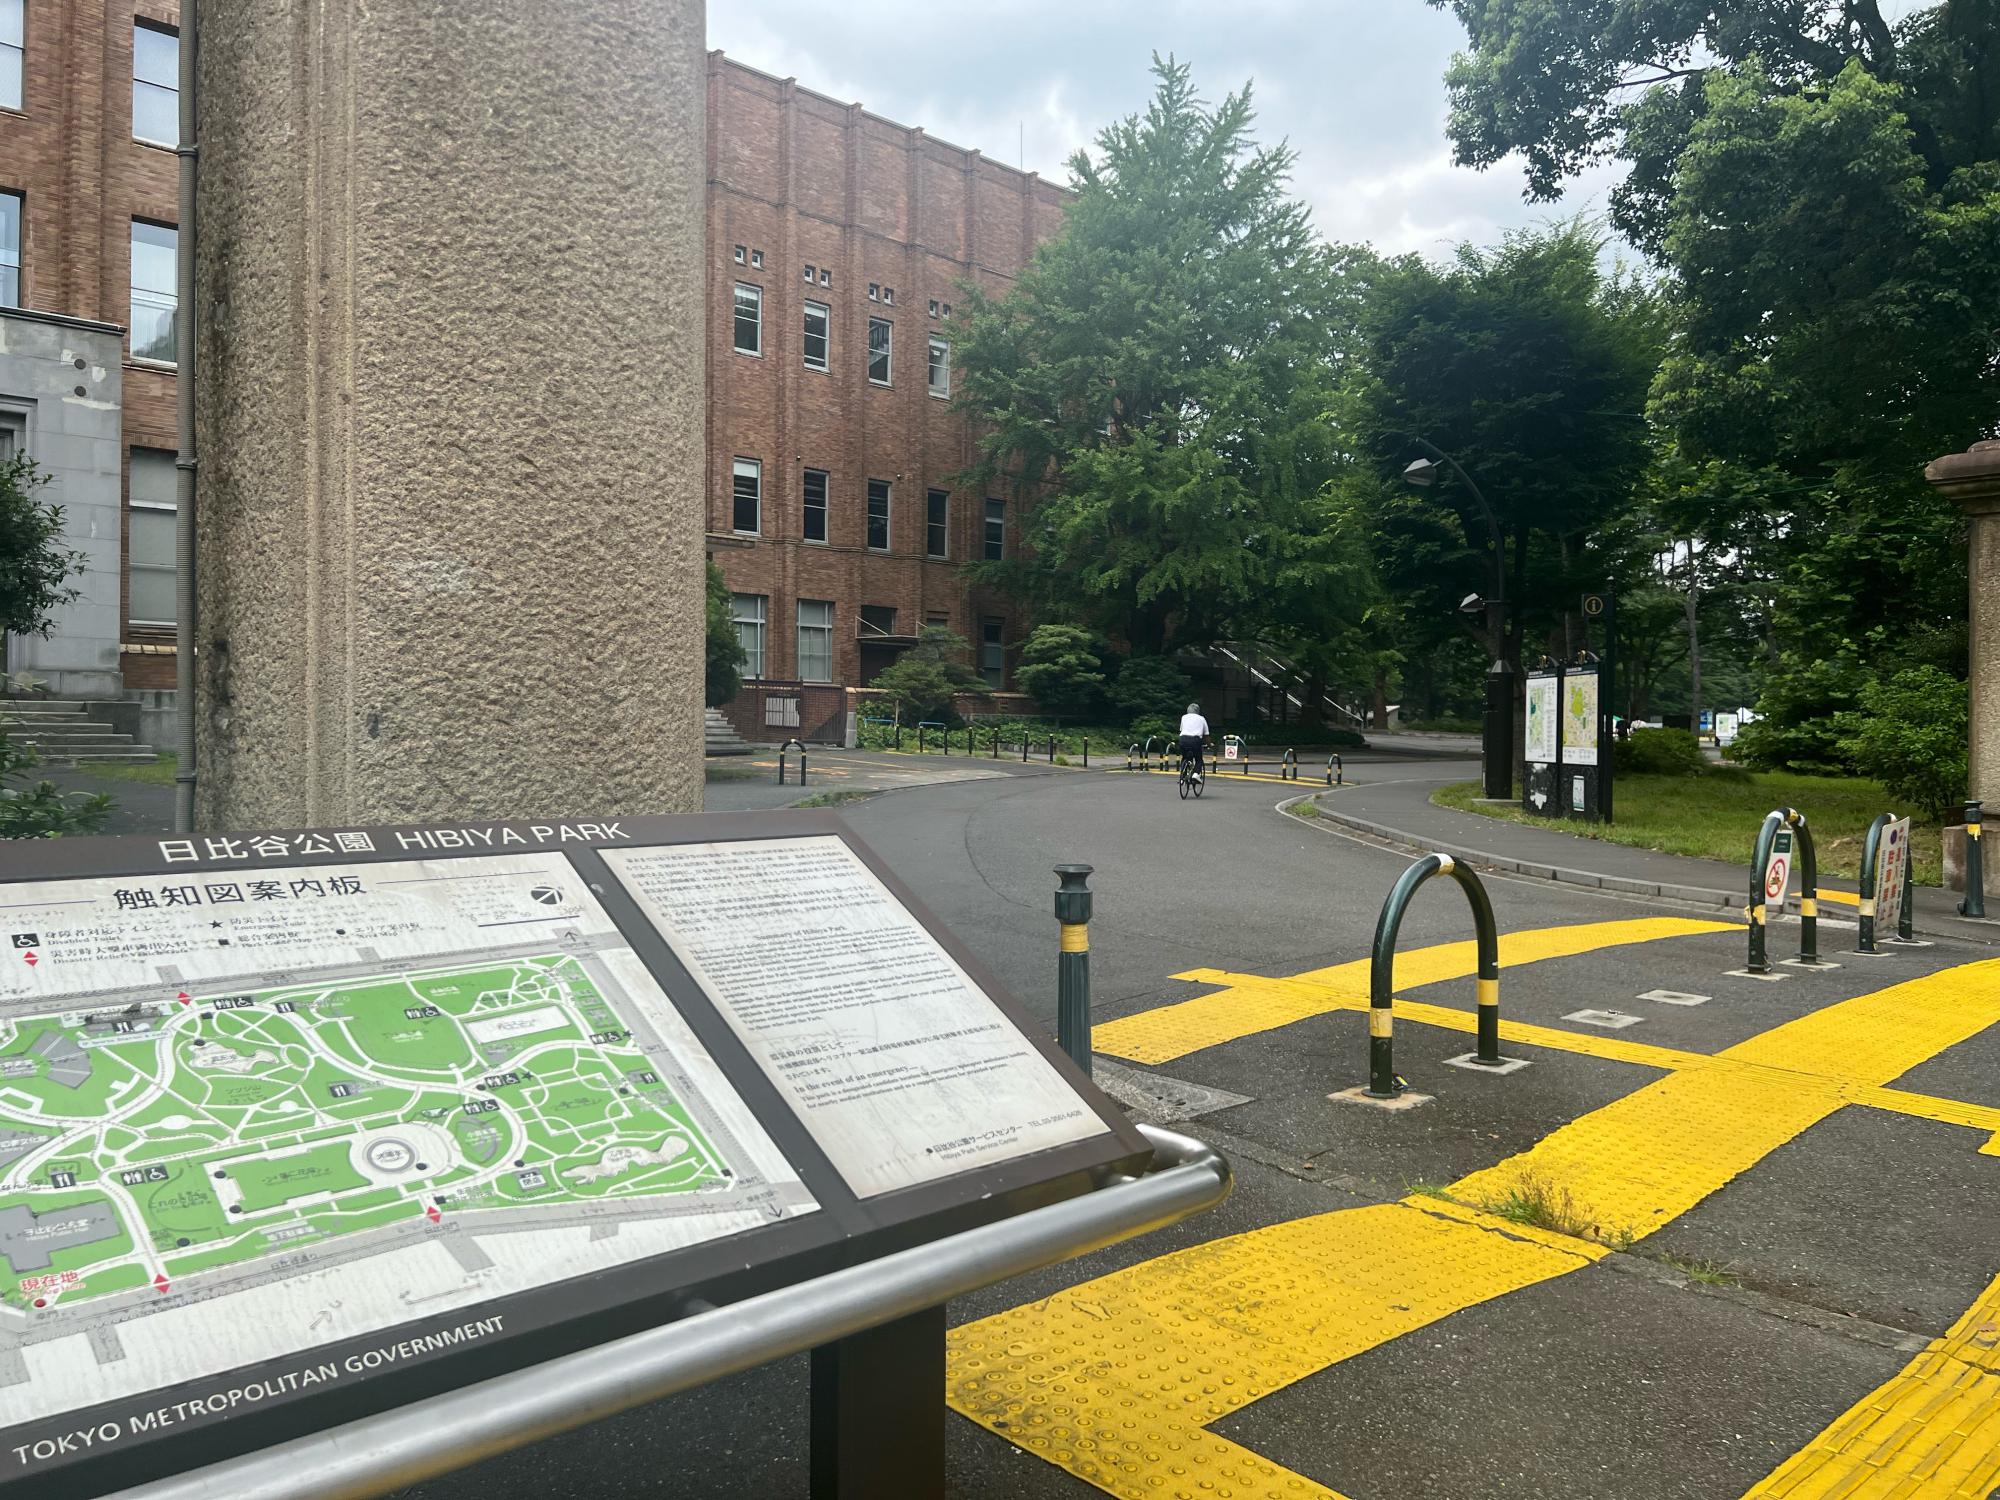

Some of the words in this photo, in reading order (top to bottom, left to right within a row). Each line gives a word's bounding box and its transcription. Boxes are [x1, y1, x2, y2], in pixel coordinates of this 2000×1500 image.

[158, 832, 376, 864] 日比谷公園
[397, 826, 526, 851] HIBIYA
[530, 822, 632, 844] PARK
[112, 876, 367, 911] 触知図案内板
[20, 1270, 80, 1290] 現在地
[12, 1421, 121, 1466] TOKYO
[130, 1361, 340, 1435] METROPOLITAN
[345, 1315, 505, 1373] GOVERNMENT
